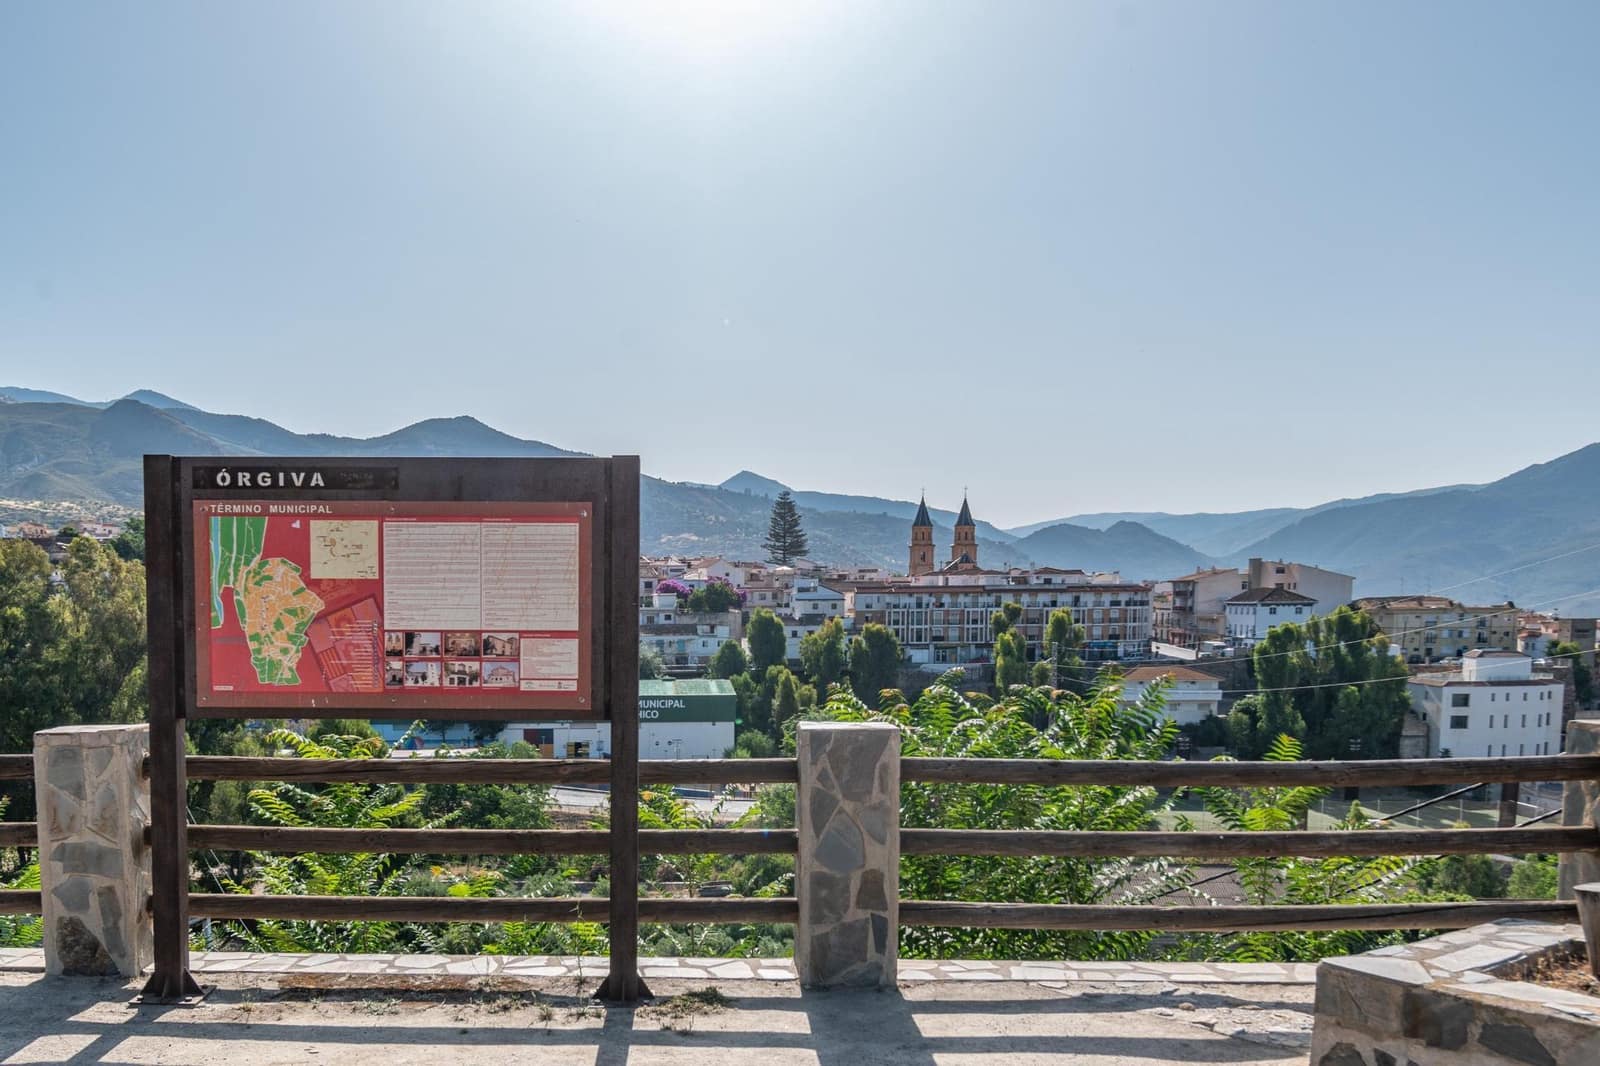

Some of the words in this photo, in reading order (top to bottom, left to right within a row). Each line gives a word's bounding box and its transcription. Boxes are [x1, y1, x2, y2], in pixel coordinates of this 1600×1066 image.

[216, 468, 325, 487] ÓRGIVA
[210, 503, 262, 513] TÉRMINO
[269, 504, 333, 514] MUNICIPAL
